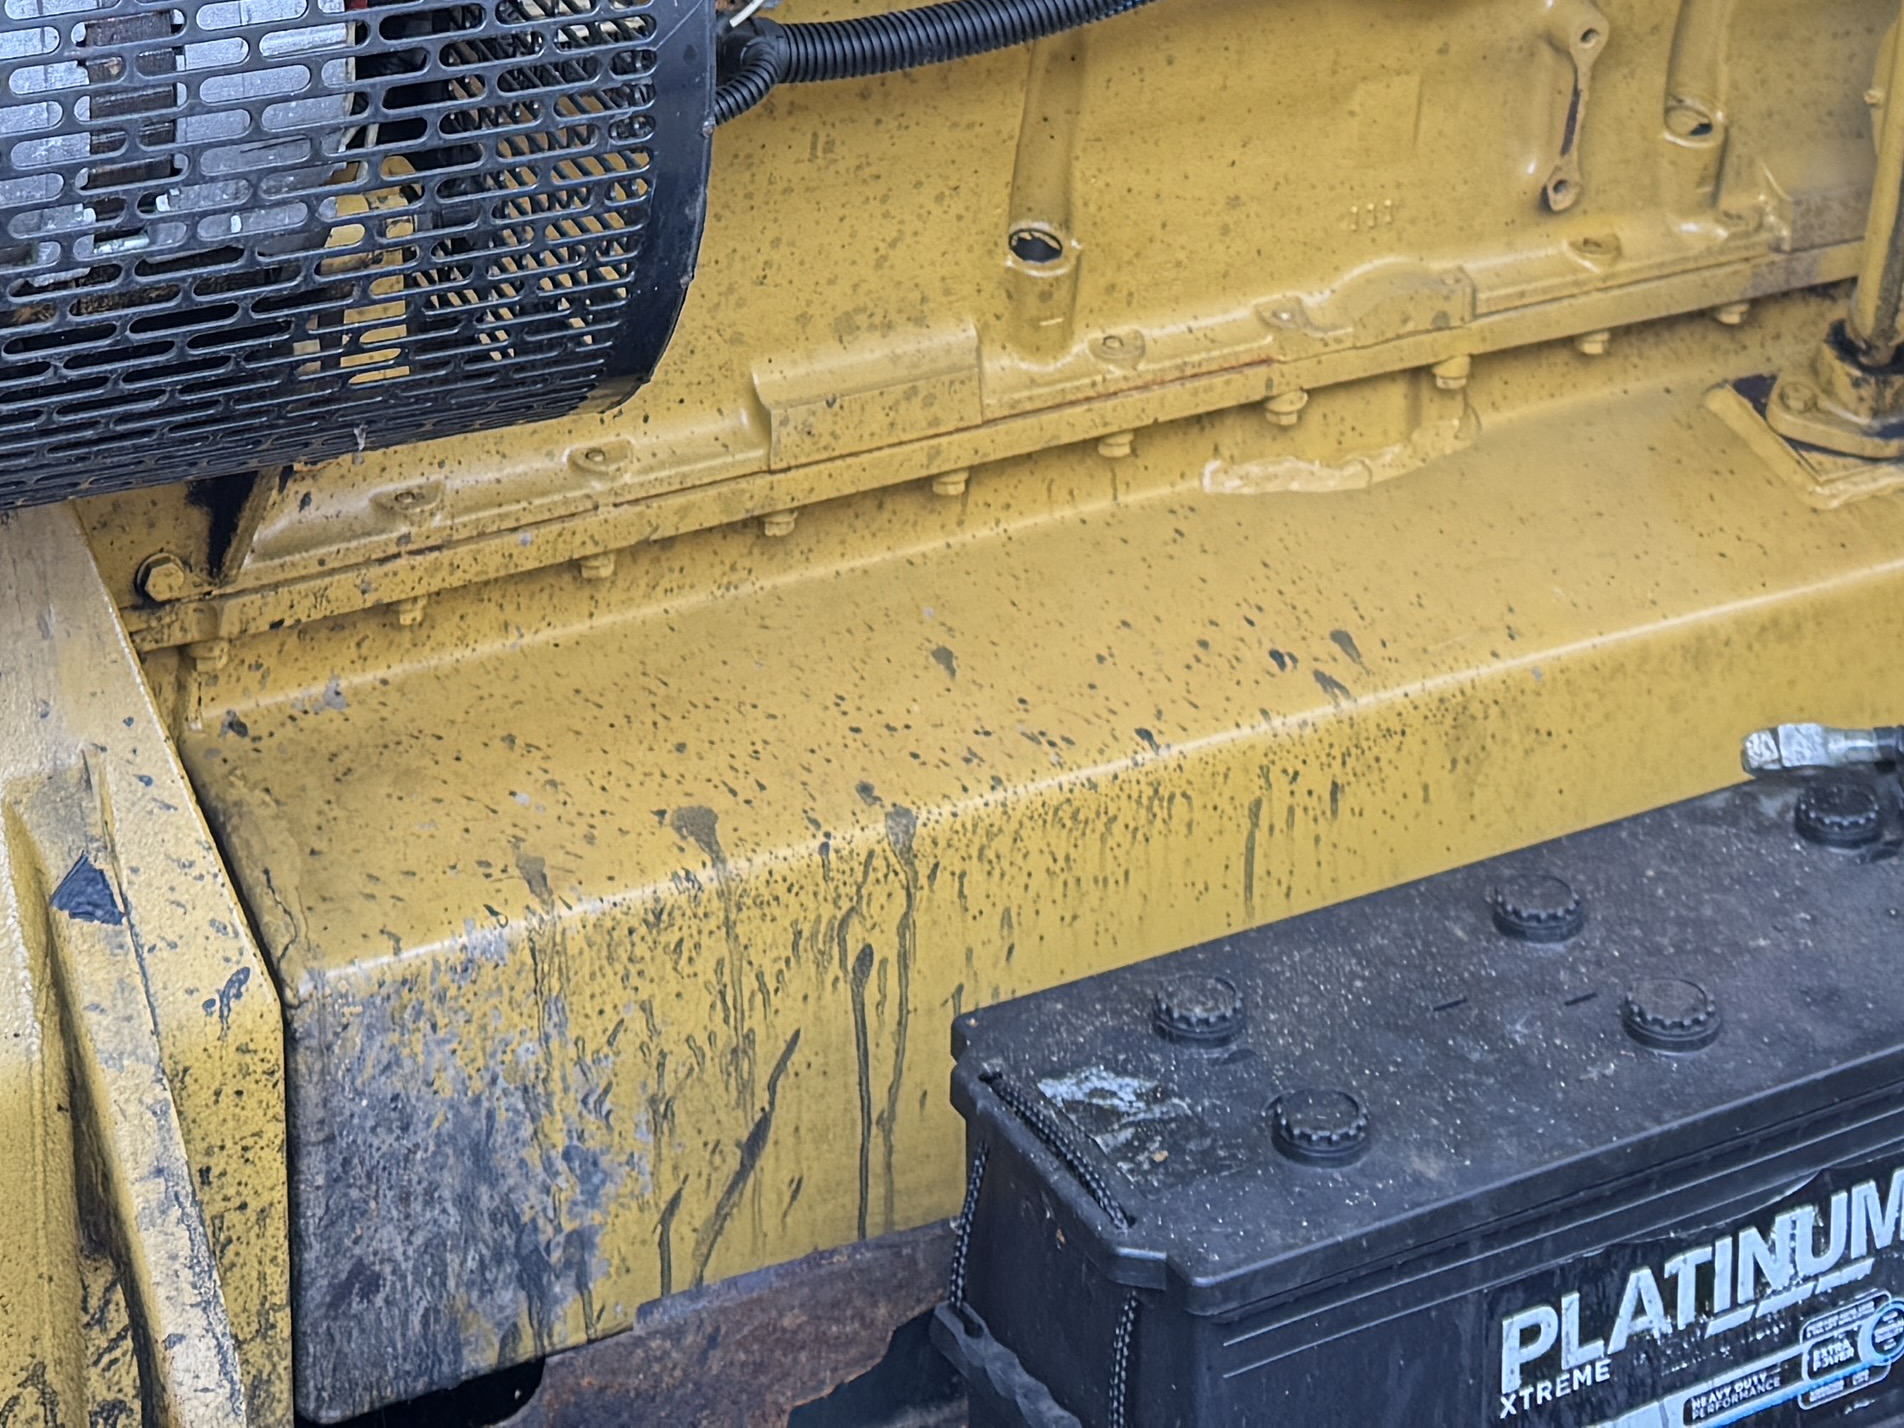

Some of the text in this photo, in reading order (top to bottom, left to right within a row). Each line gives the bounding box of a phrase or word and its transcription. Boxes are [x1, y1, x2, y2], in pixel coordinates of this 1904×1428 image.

[1498, 1357, 1613, 1419] XTREME
[1691, 1371, 1769, 1410] HEAVY DUTY
[1691, 1375, 1782, 1421] PERFORMANCE
